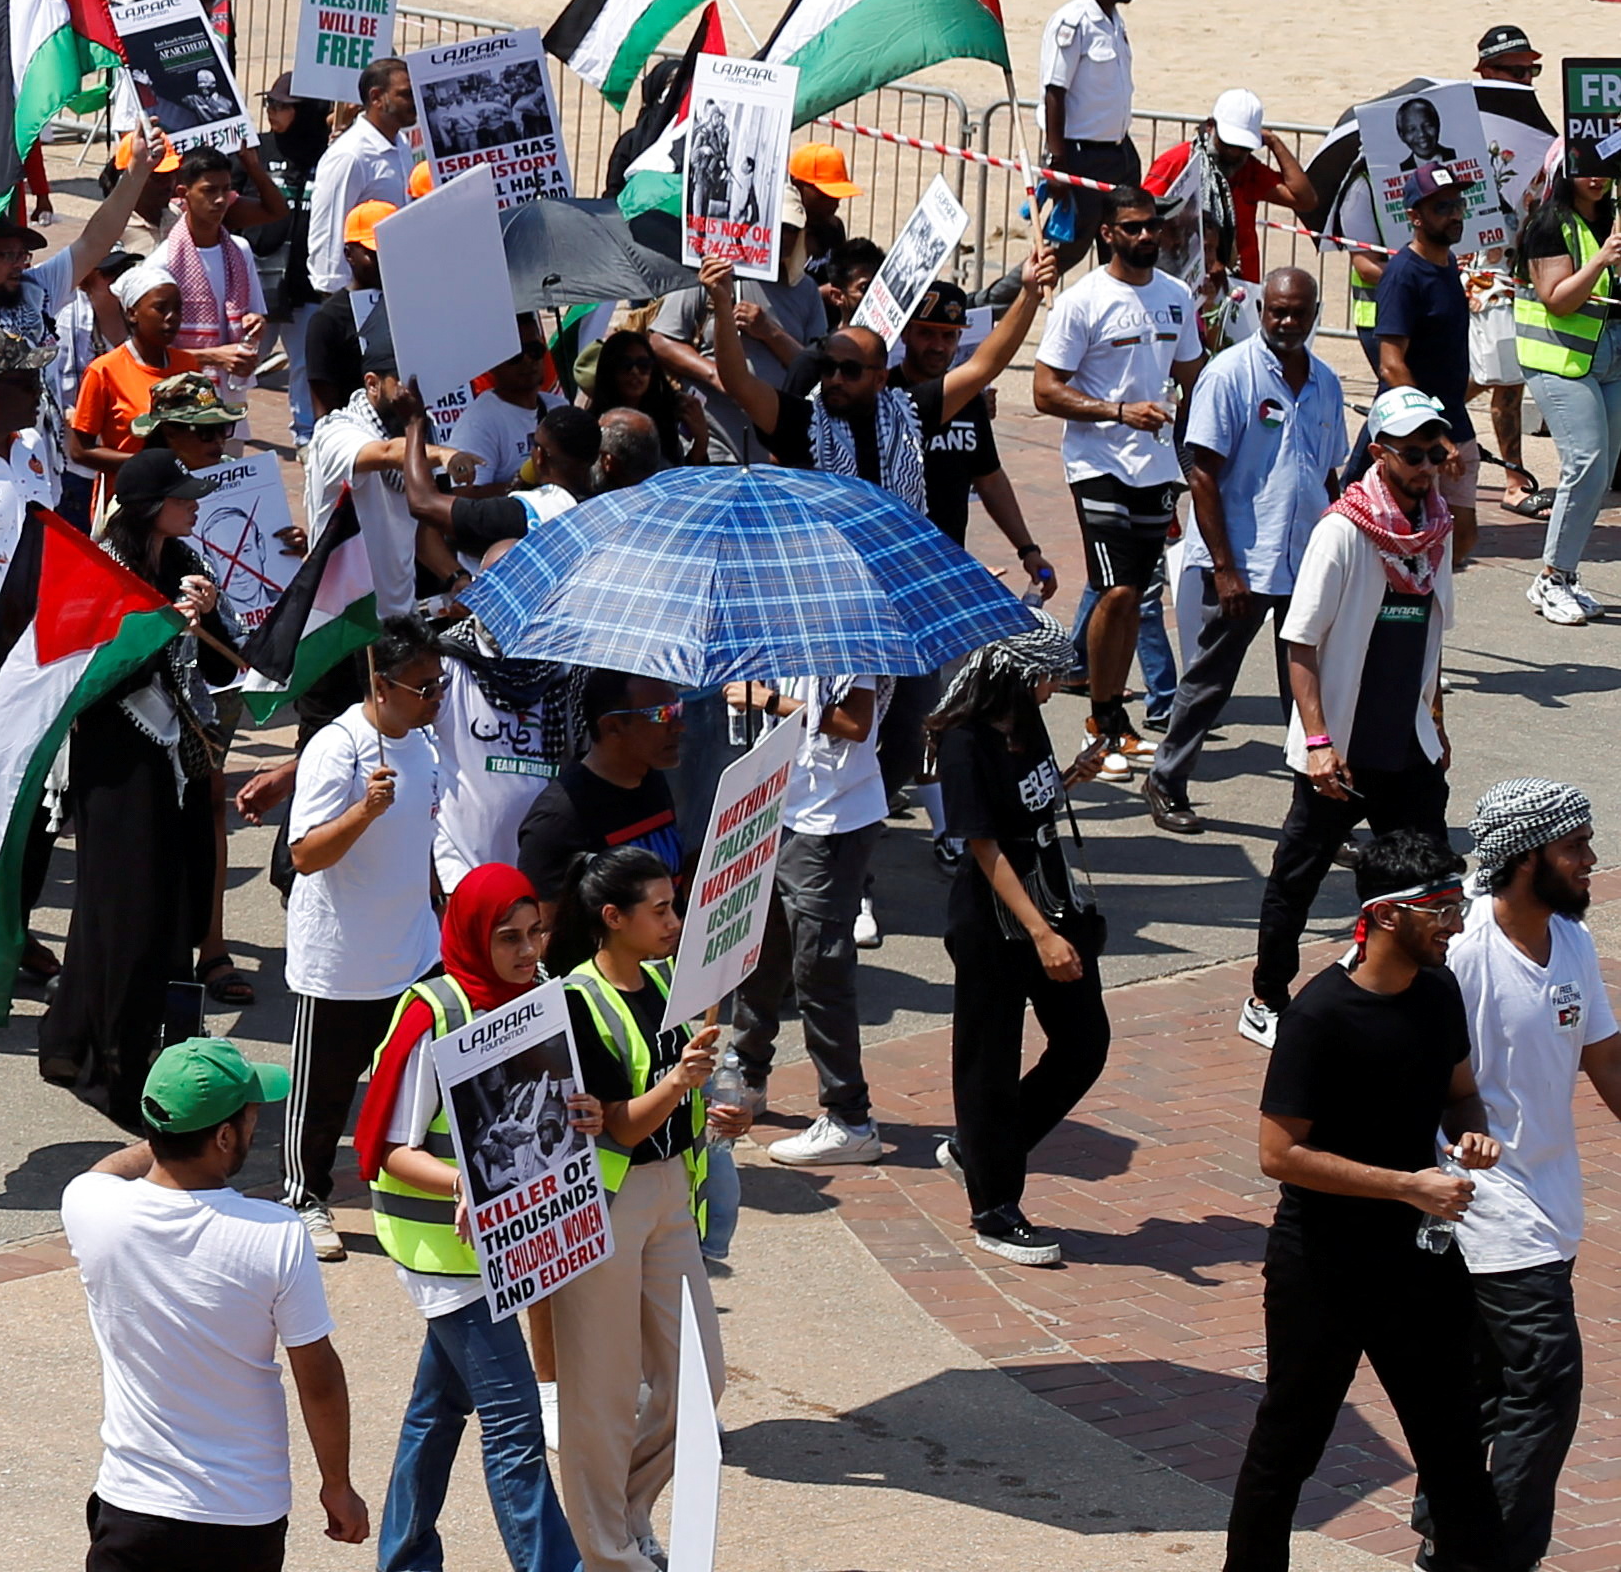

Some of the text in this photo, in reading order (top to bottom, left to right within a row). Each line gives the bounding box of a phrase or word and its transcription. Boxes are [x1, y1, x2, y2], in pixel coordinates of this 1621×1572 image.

[318, 10, 379, 38] WILL BE
[159, 39, 210, 61] APARTHEID
[315, 32, 375, 71] FREE
[430, 38, 518, 65] LAJPAAL
[451, 51, 501, 68] FOUNDATION
[712, 61, 778, 83] LAJPAAL
[436, 137, 557, 176] ISRAEL HAS
[551, 168, 564, 184] A
[721, 221, 772, 244] NOT OK
[1478, 227, 1505, 245] PAO
[919, 291, 939, 318] 7
[491, 758, 553, 777] TEAM MEMBER
[715, 761, 791, 841] WATHINTHA
[709, 796, 784, 873] iPALESTINE
[699, 830, 777, 910] WATHINTHA
[701, 909, 754, 969] AFRIKA
[458, 1002, 545, 1055] LAJPAAL
[480, 1024, 528, 1055] FOUNDATION
[476, 1153, 594, 1232] KILLER OF
[481, 1177, 599, 1256] THOUSANDS
[487, 1201, 604, 1290] OF CHILDREN, WOMEN
[496, 1234, 607, 1315] AND ELDERLY
